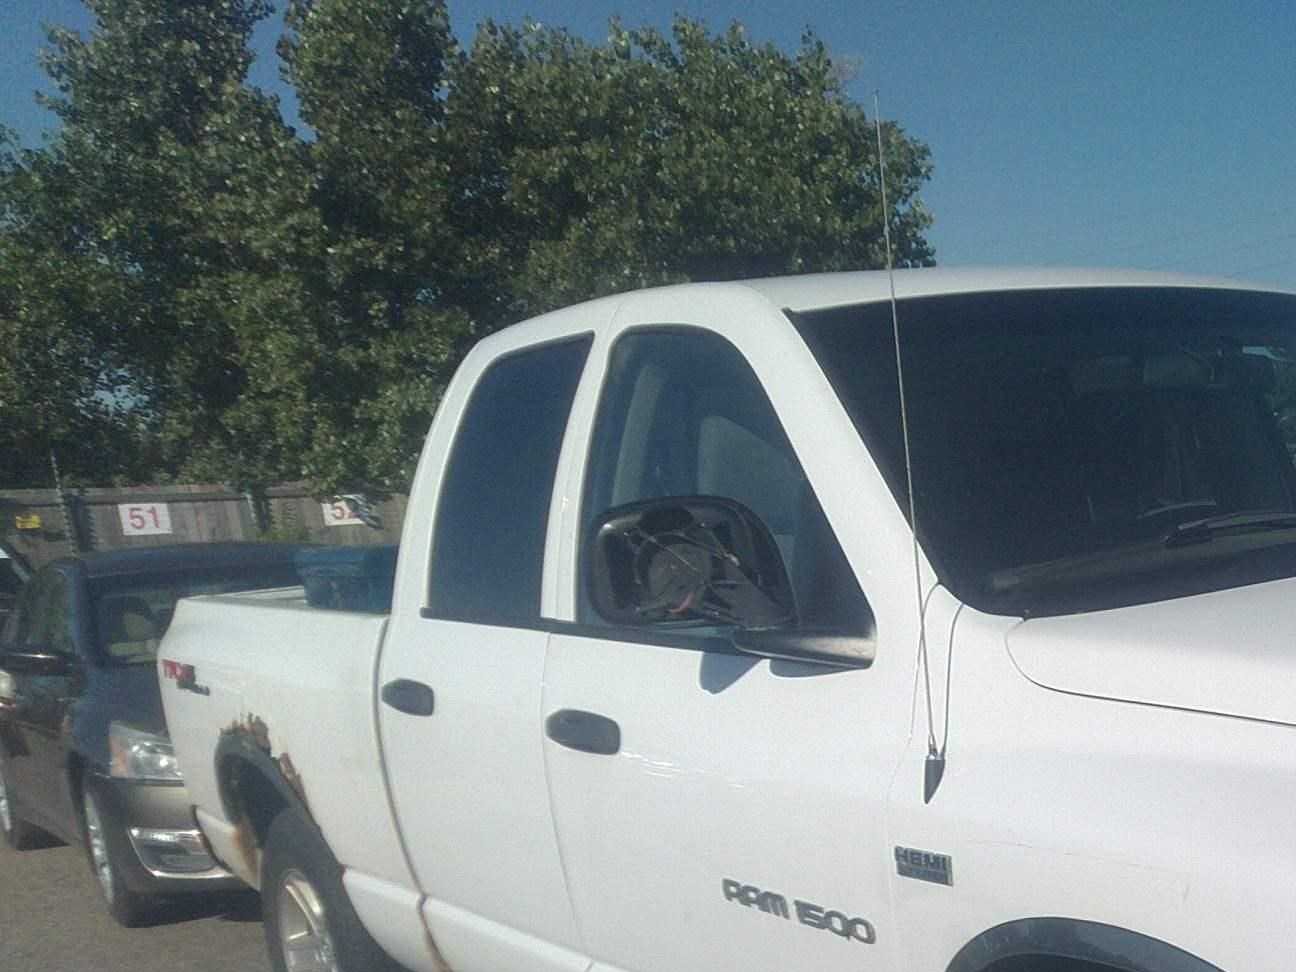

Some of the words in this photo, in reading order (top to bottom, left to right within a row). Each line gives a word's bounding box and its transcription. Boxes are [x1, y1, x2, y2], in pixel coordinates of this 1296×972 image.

[128, 507, 160, 529] 51
[895, 845, 946, 872] HEMI
[722, 878, 789, 920] RAM
[793, 899, 876, 945] 1500
